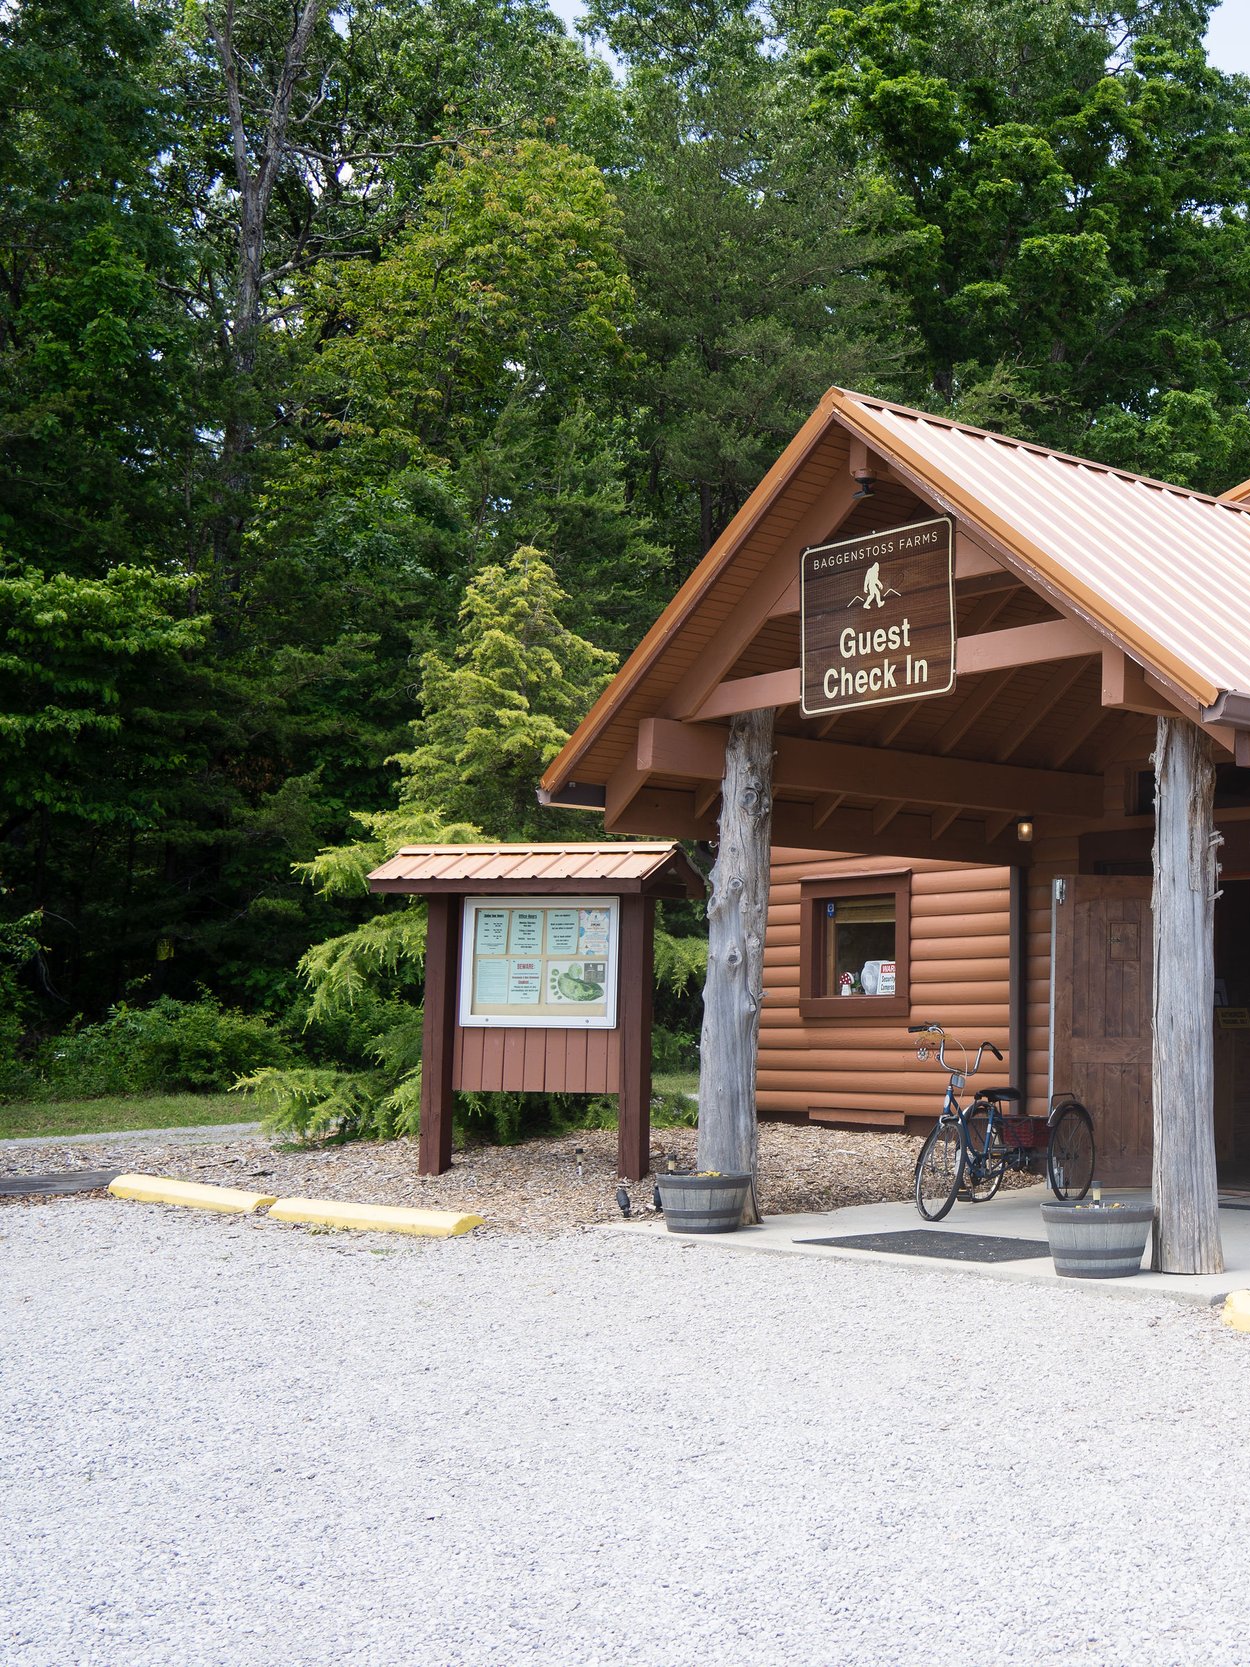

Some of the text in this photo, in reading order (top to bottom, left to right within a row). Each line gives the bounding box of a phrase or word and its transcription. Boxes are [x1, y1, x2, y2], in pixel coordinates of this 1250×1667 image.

[813, 531, 939, 571] BAGGENSTOSS FARMS
[839, 618, 911, 659] Guest
[823, 654, 929, 700] Check In
